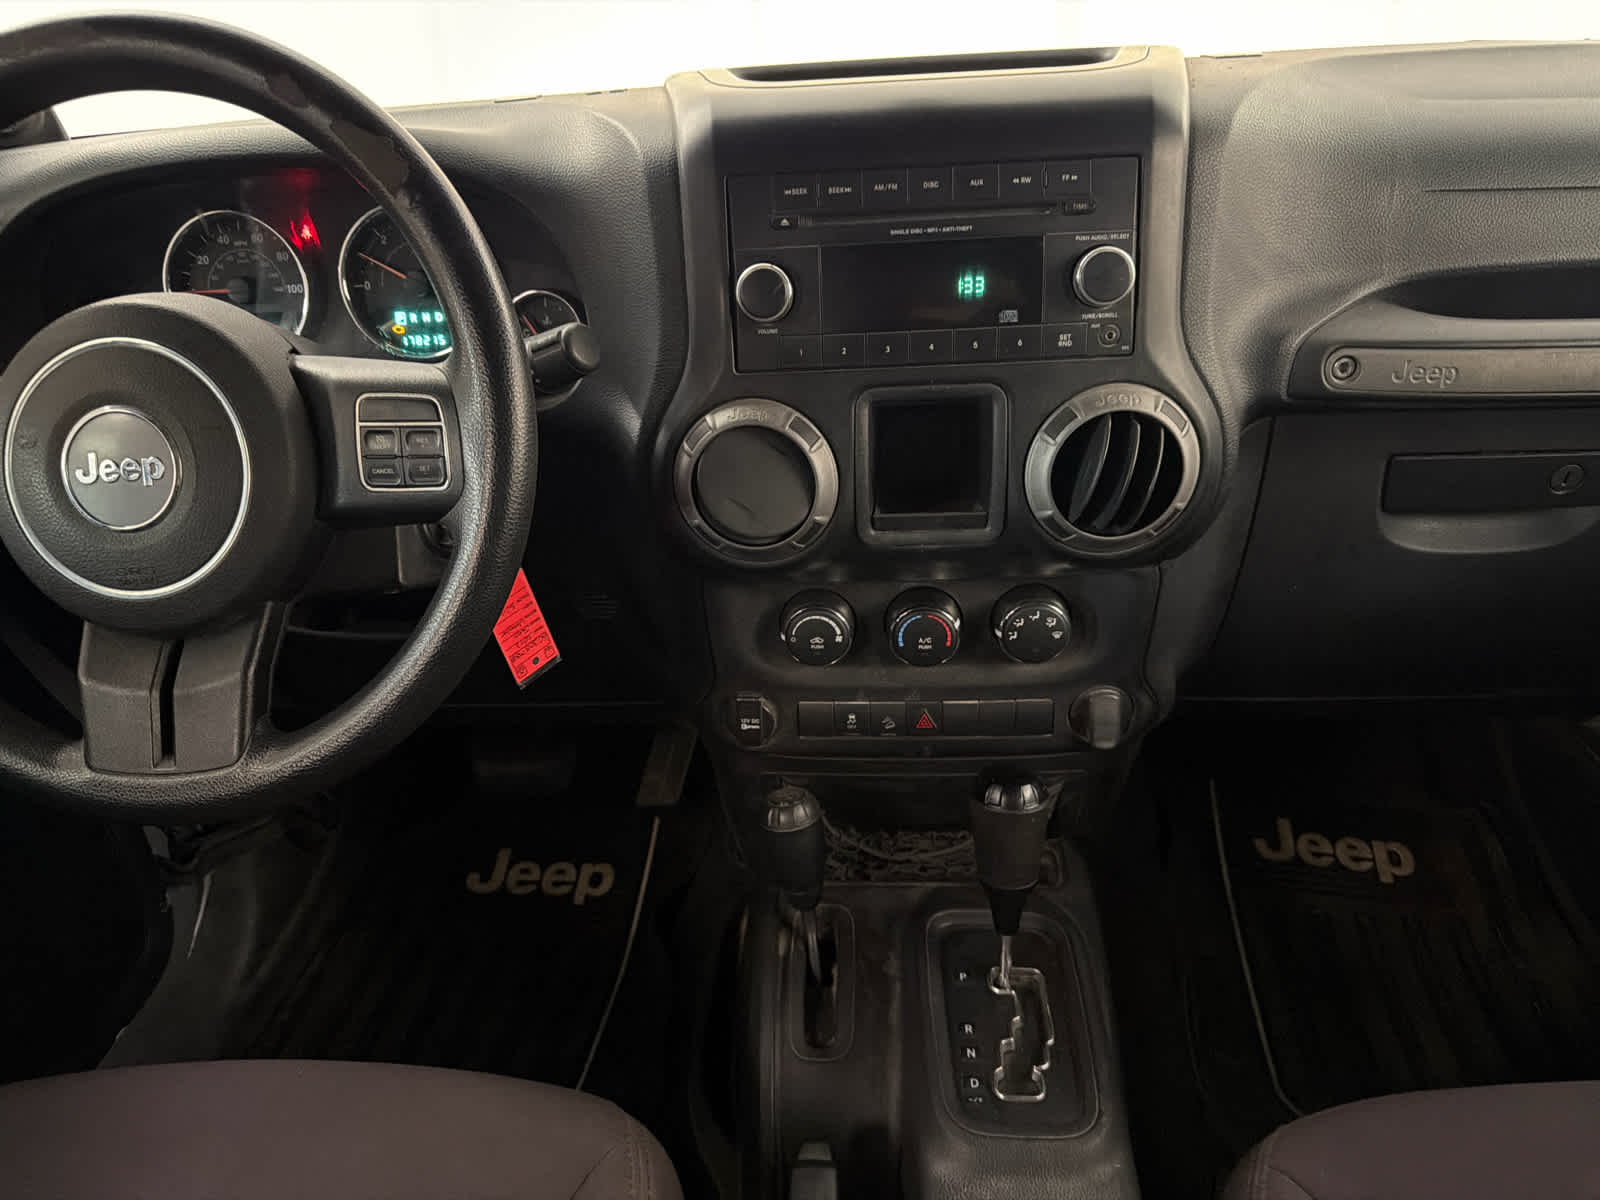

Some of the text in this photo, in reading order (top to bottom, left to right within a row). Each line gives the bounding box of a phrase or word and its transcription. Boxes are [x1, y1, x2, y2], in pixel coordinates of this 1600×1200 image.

[873, 183, 898, 191] AM/FM
[923, 181, 939, 189] DISC
[969, 178, 984, 186] AUX
[216, 234, 230, 245] 40
[198, 255, 210, 265] 20
[287, 284, 304, 294] 100
[1391, 359, 1458, 388] Jeep
[74, 452, 165, 486] Jeep
[1254, 816, 1415, 883] Jeep
[466, 848, 615, 905] Jeep
[959, 972, 967, 982] P
[964, 1023, 973, 1034] R
[966, 1047, 976, 1058] N
[970, 1078, 980, 1088] D
